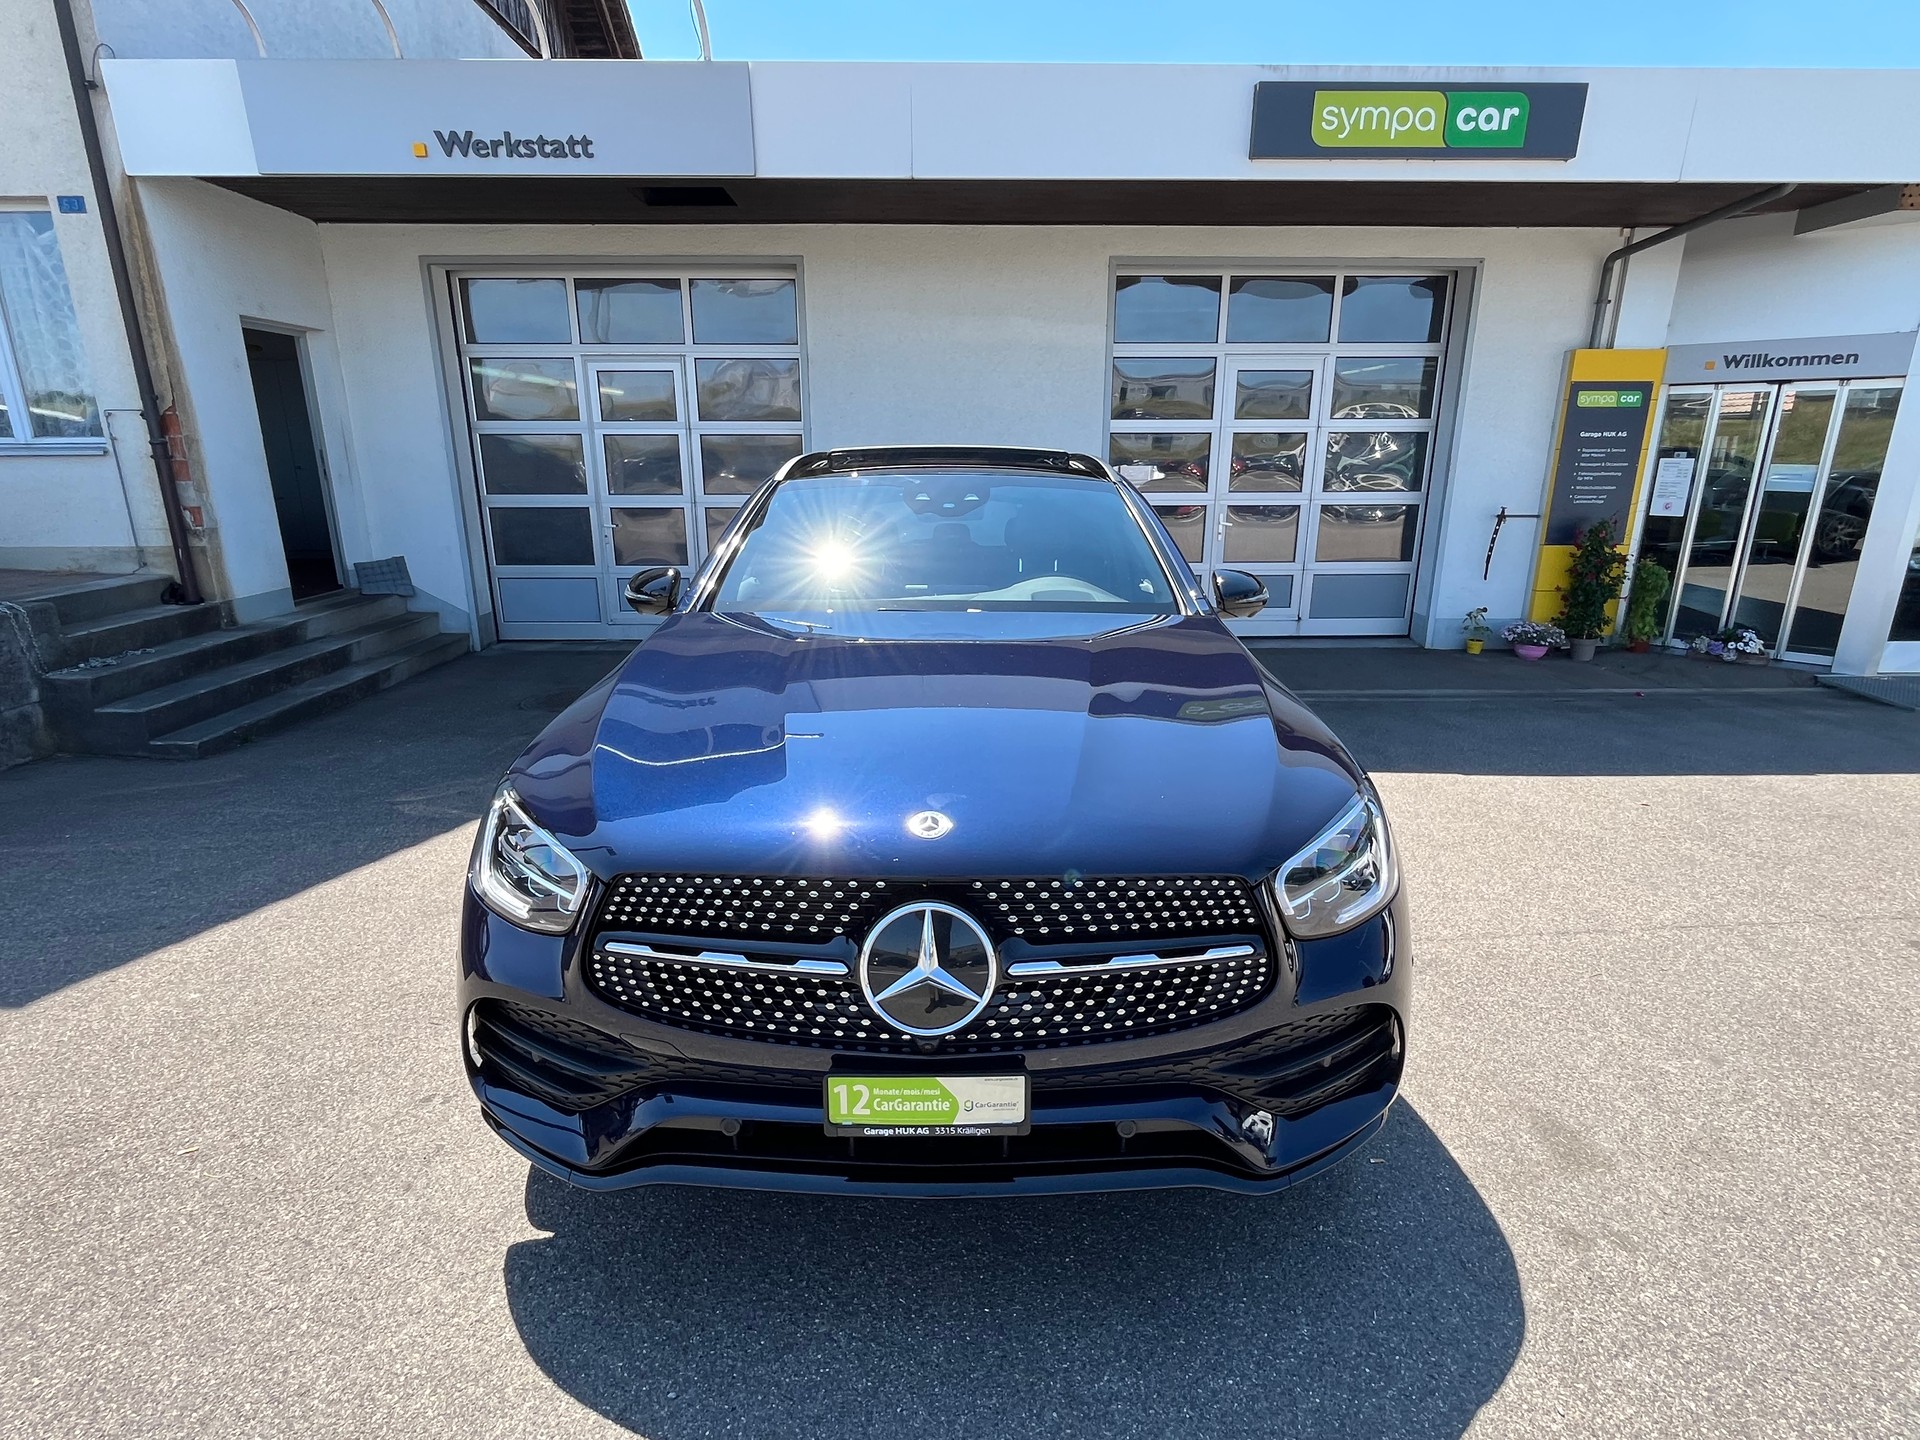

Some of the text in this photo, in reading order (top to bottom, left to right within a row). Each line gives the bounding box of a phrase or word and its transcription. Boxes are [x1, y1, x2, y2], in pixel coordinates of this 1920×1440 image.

[1321, 105, 1520, 140] sympa car
[433, 130, 595, 159] Werkstatt
[1723, 353, 1860, 370] Willkommen
[1580, 395, 1640, 405] sympa car
[833, 1084, 870, 1115] 12
[864, 1127, 894, 1136] Garage
[895, 1127, 915, 1135] HUK
[915, 1127, 929, 1135] AG
[934, 1127, 956, 1135] 3315
